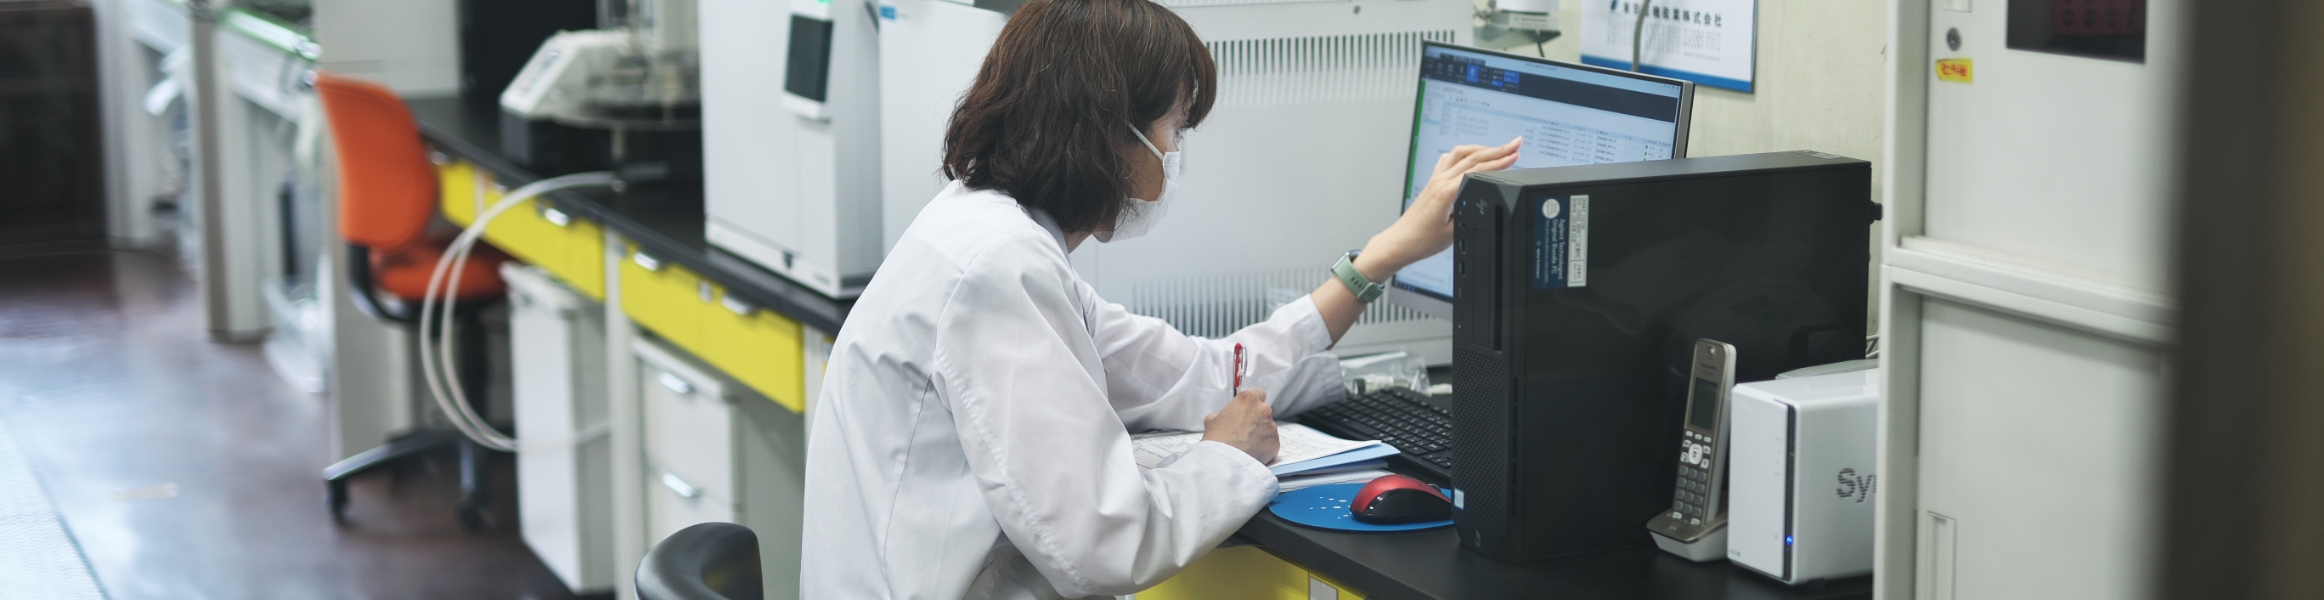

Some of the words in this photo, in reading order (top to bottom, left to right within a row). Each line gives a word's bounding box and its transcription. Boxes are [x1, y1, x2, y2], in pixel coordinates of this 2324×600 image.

[1558, 218, 1566, 240] Agilent
[1551, 265, 1558, 275] PC
[1557, 241, 1566, 280] Technologies
